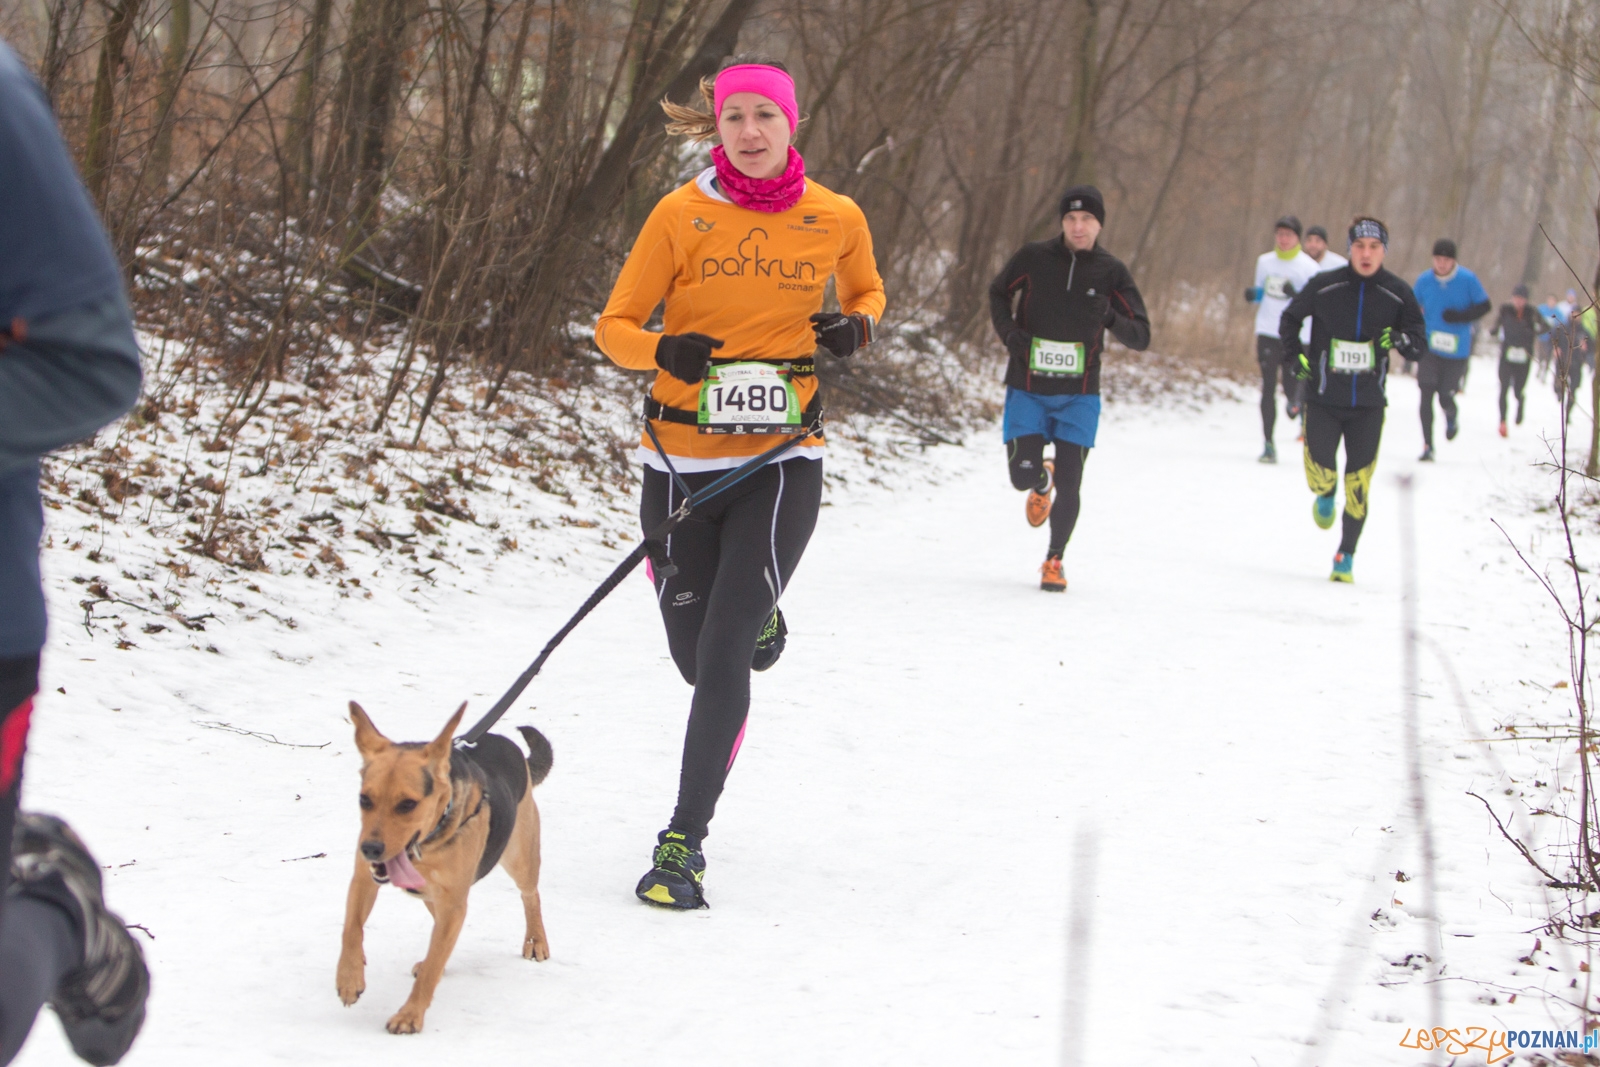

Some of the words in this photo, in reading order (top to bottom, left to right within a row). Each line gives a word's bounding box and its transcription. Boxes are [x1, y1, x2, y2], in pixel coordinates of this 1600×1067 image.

[700, 234, 816, 284] parkrun
[1038, 351, 1075, 367] 1690
[1340, 350, 1367, 364] 1191
[712, 384, 788, 412] 1480
[730, 414, 771, 422] AGNIESZKA
